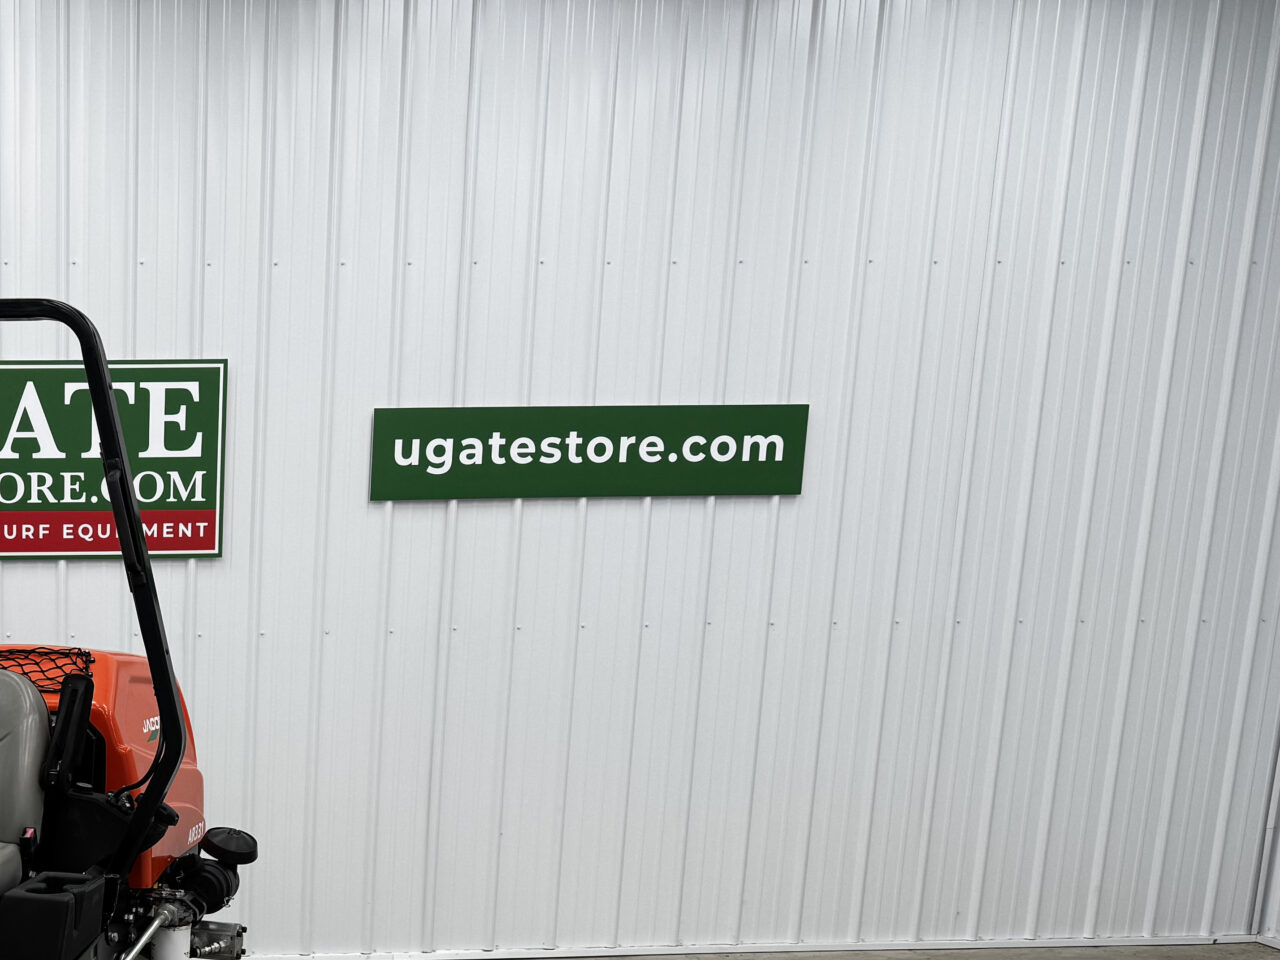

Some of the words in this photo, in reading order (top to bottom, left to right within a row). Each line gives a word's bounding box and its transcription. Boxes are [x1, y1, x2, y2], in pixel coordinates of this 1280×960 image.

[394, 431, 785, 475] ugatestore.com
[62, 522, 209, 542] EQUMENT
[142, 715, 160, 733] JACO
